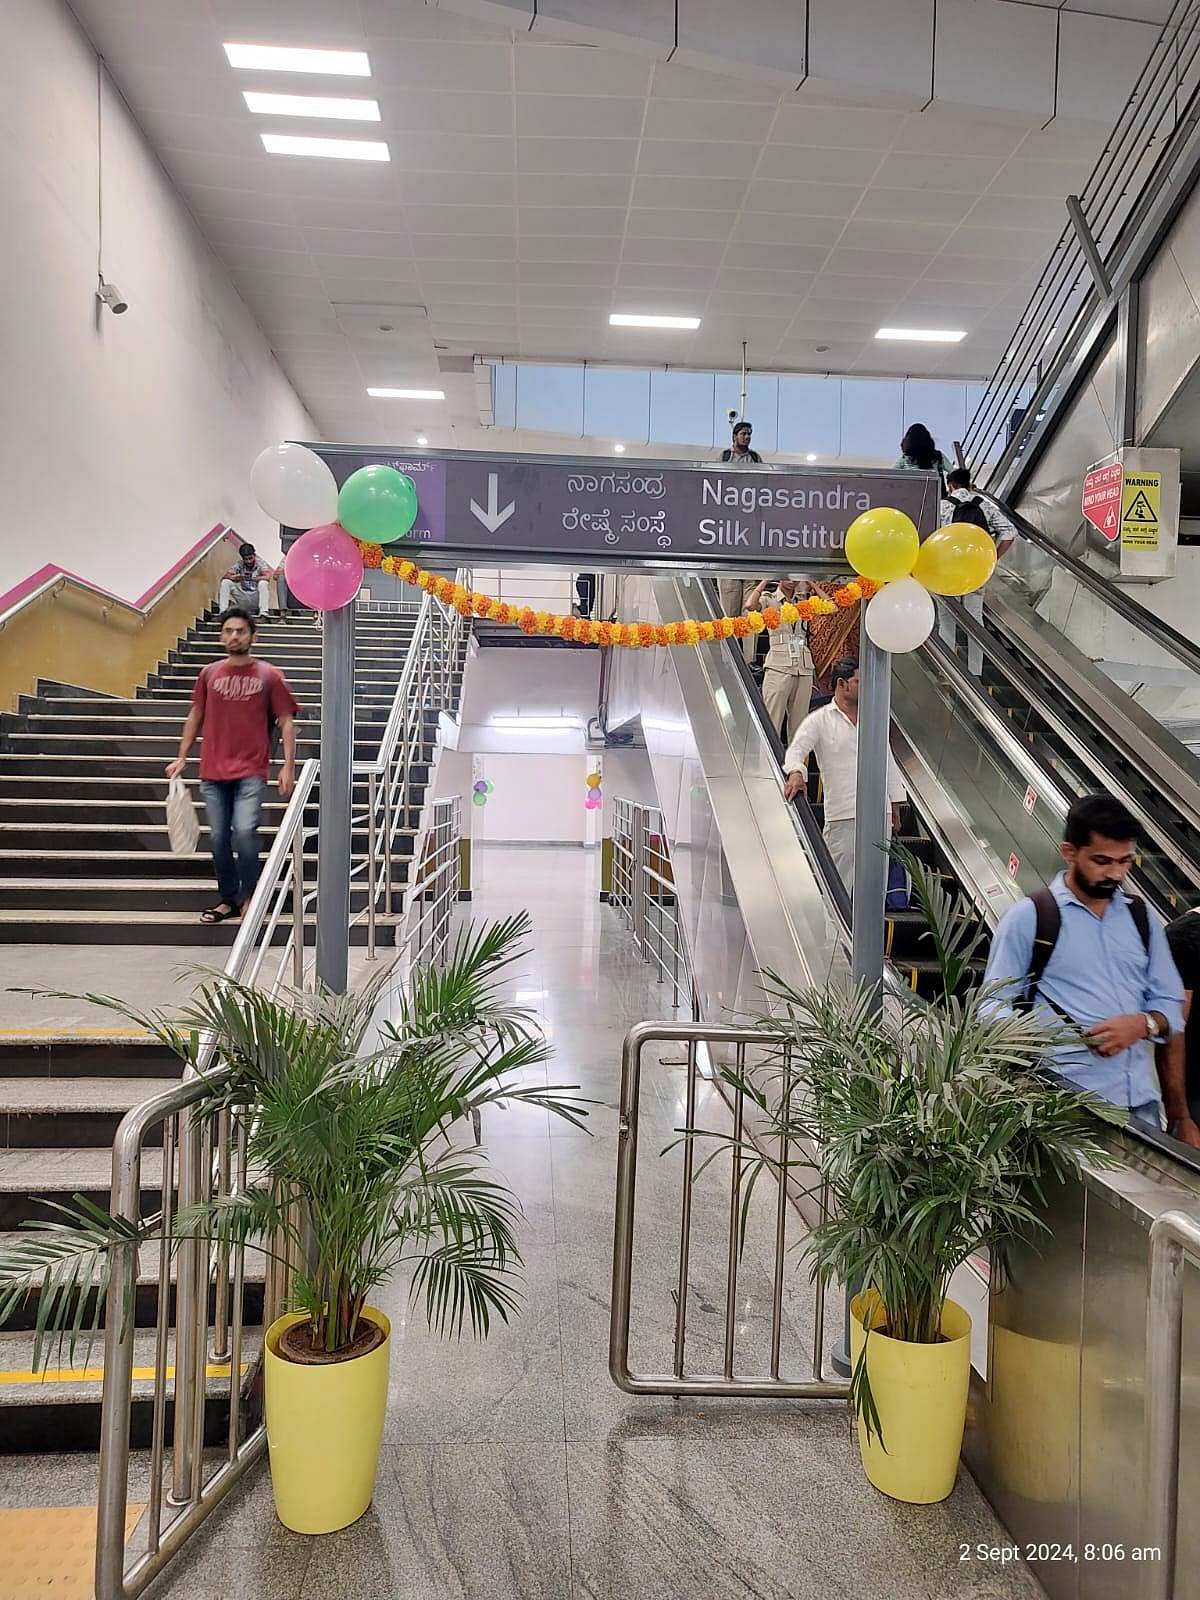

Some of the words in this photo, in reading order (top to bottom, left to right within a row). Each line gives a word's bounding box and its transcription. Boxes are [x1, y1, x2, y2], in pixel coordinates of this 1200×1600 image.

[568, 472, 667, 500] ನಾಗಸಂದ್ರ
[702, 478, 871, 513] Nagasandra
[1125, 478, 1159, 487] WARNING
[562, 507, 620, 545] ರೇಷ್ಮೆ
[621, 510, 672, 549] ಸಂಸ್ಥೆ
[698, 518, 750, 546] Silk
[760, 520, 846, 550] Institu
